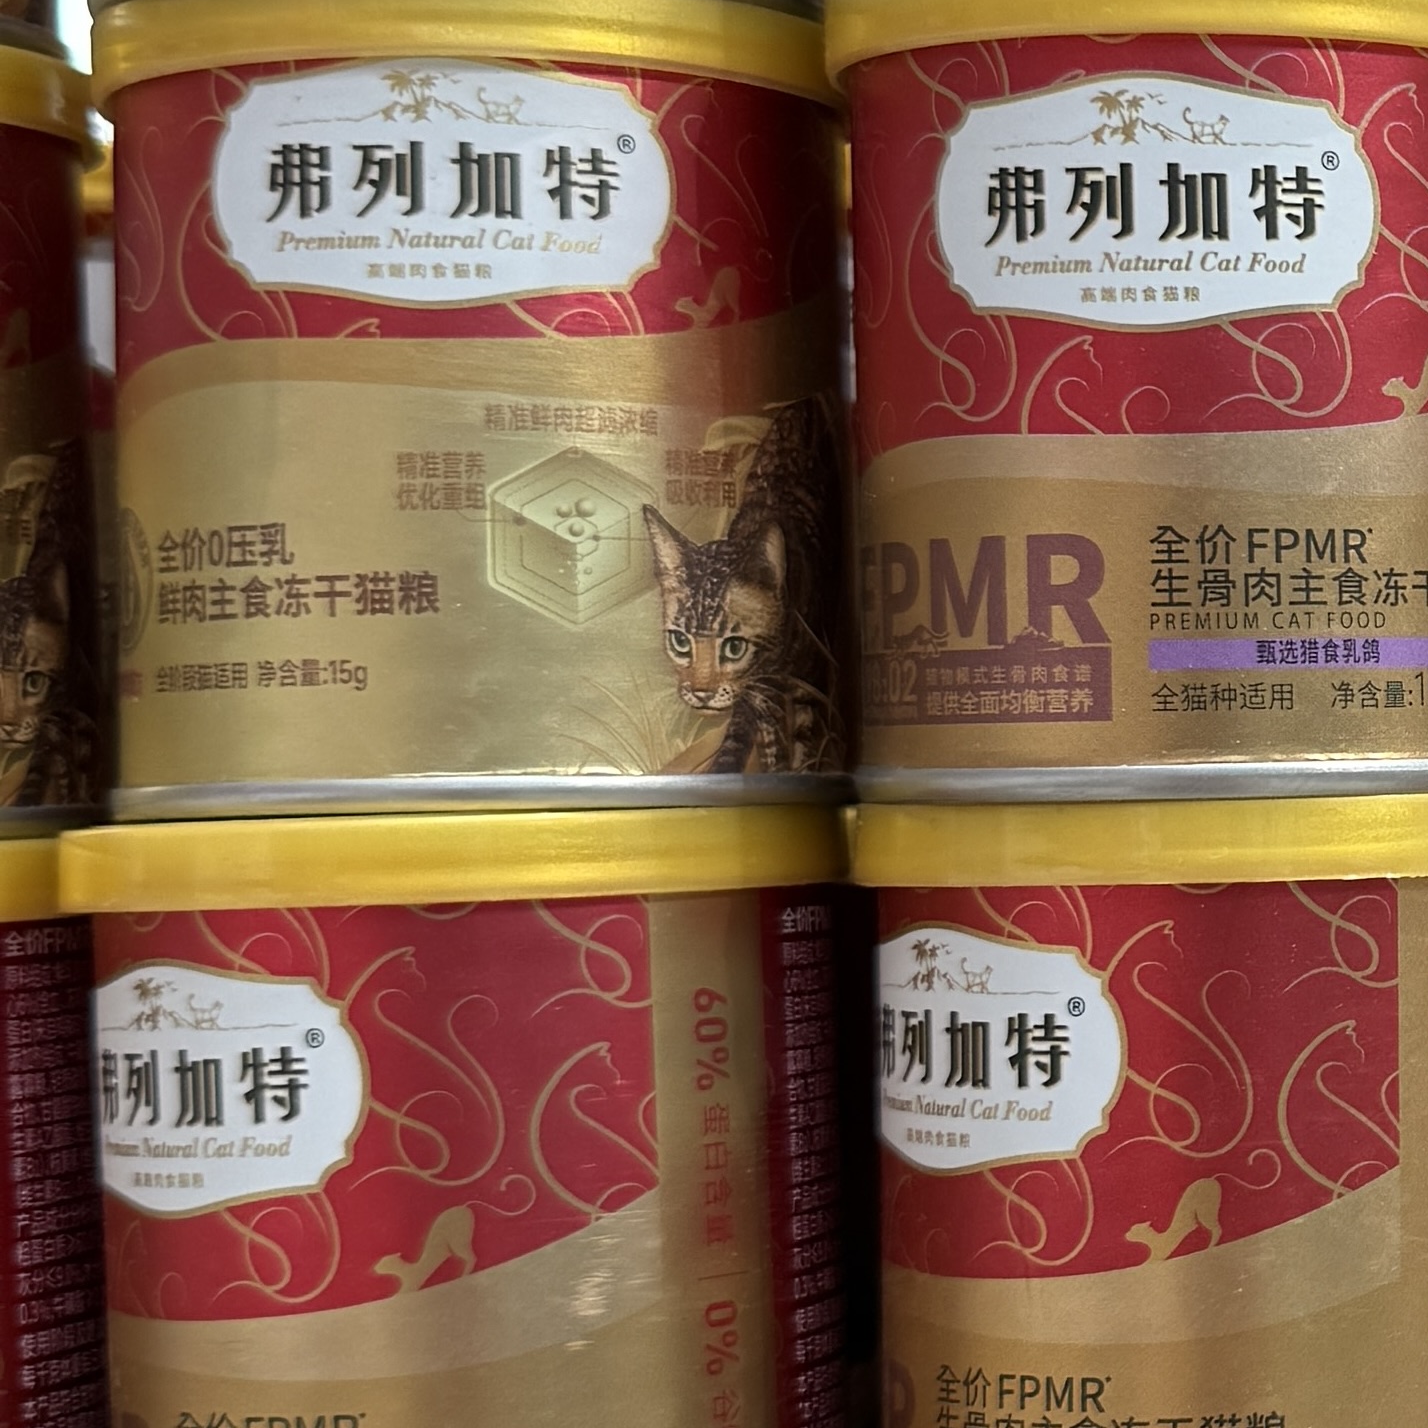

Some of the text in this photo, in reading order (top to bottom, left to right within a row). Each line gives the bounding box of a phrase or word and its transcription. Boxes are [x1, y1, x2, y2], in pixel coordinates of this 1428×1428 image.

[266, 140, 620, 222] 弗列加特
[984, 162, 1325, 247] 弗列加特
[1080, 286, 1201, 304] 高端肉食猫粮
[1150, 526, 1369, 567] 全价FPMR
[1150, 611, 1386, 631] PREMIUM CAT FOOD
[1256, 640, 1381, 667] 甄选猎食乳鸽
[1151, 682, 1295, 713] 全猫种适用
[936, 1365, 1106, 1413] 全价FPMR
